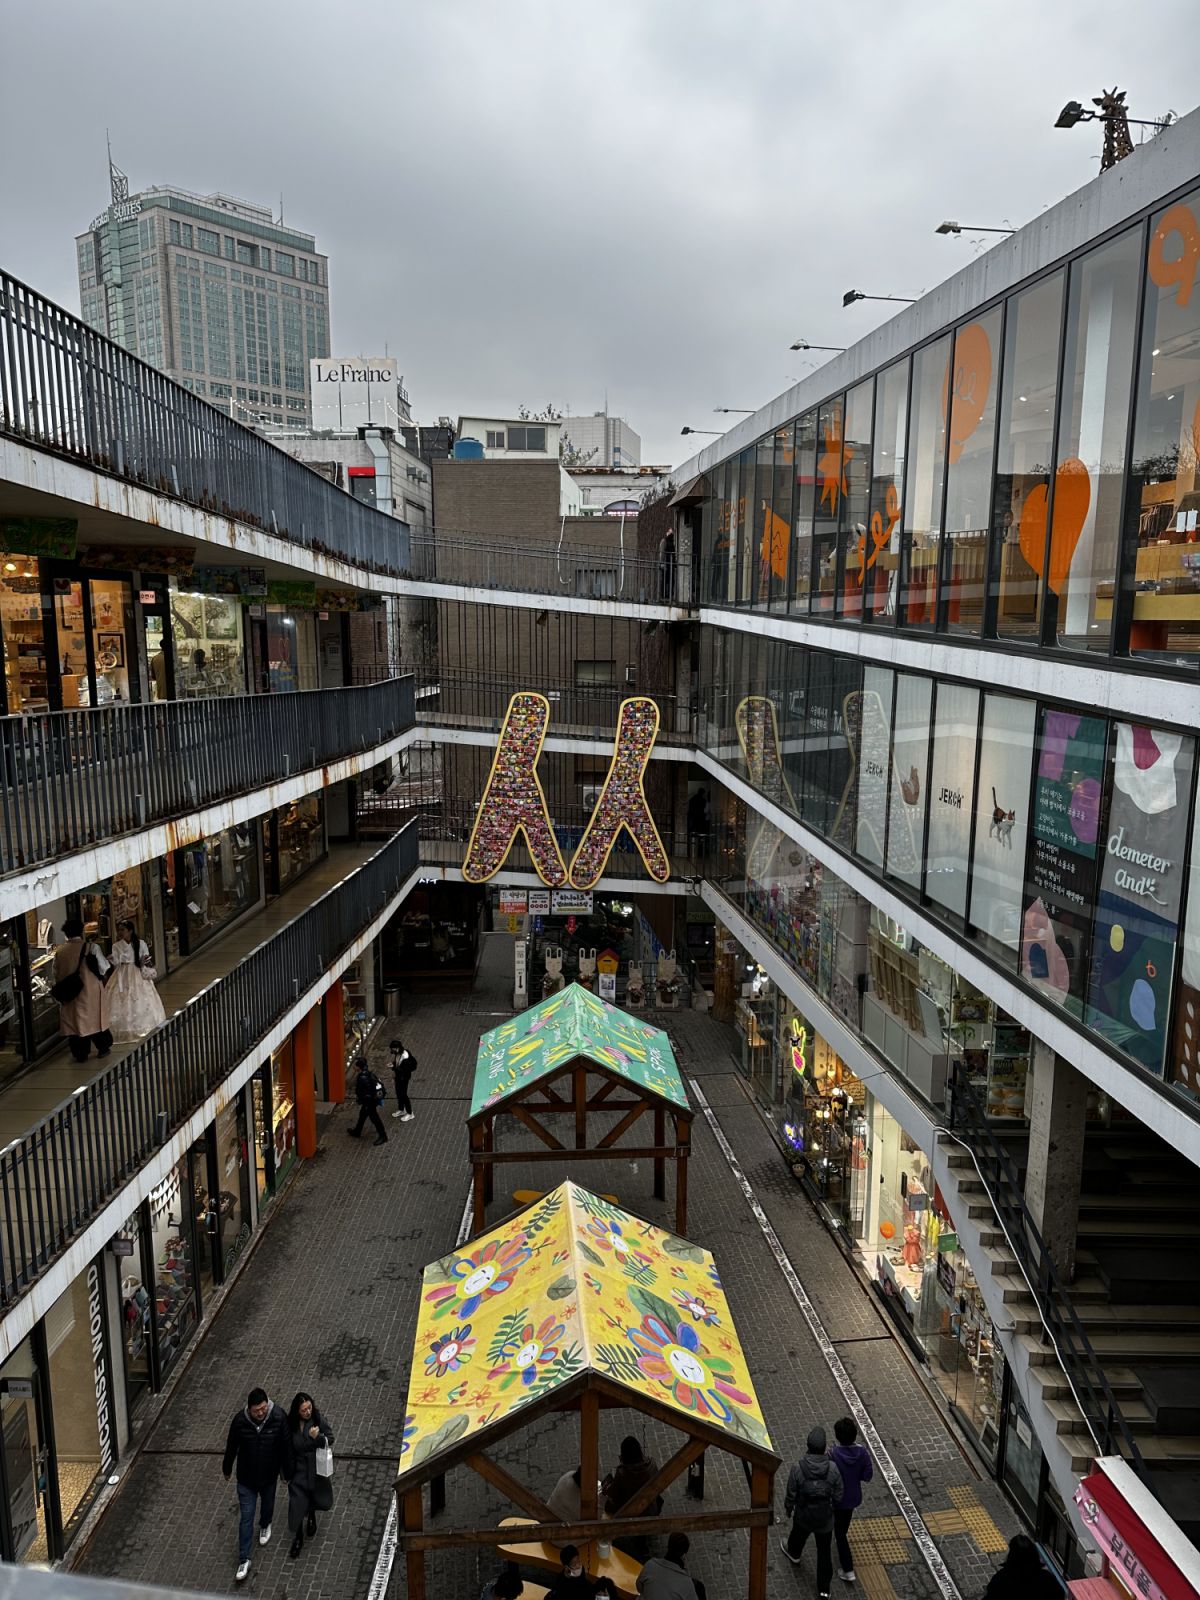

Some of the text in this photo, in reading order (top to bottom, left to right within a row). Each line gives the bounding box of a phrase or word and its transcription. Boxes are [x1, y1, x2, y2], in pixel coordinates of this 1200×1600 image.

[114, 201, 142, 219] SUITES
[1107, 826, 1171, 874] demeter
[87, 1264, 112, 1473] INCENSE WORLD
